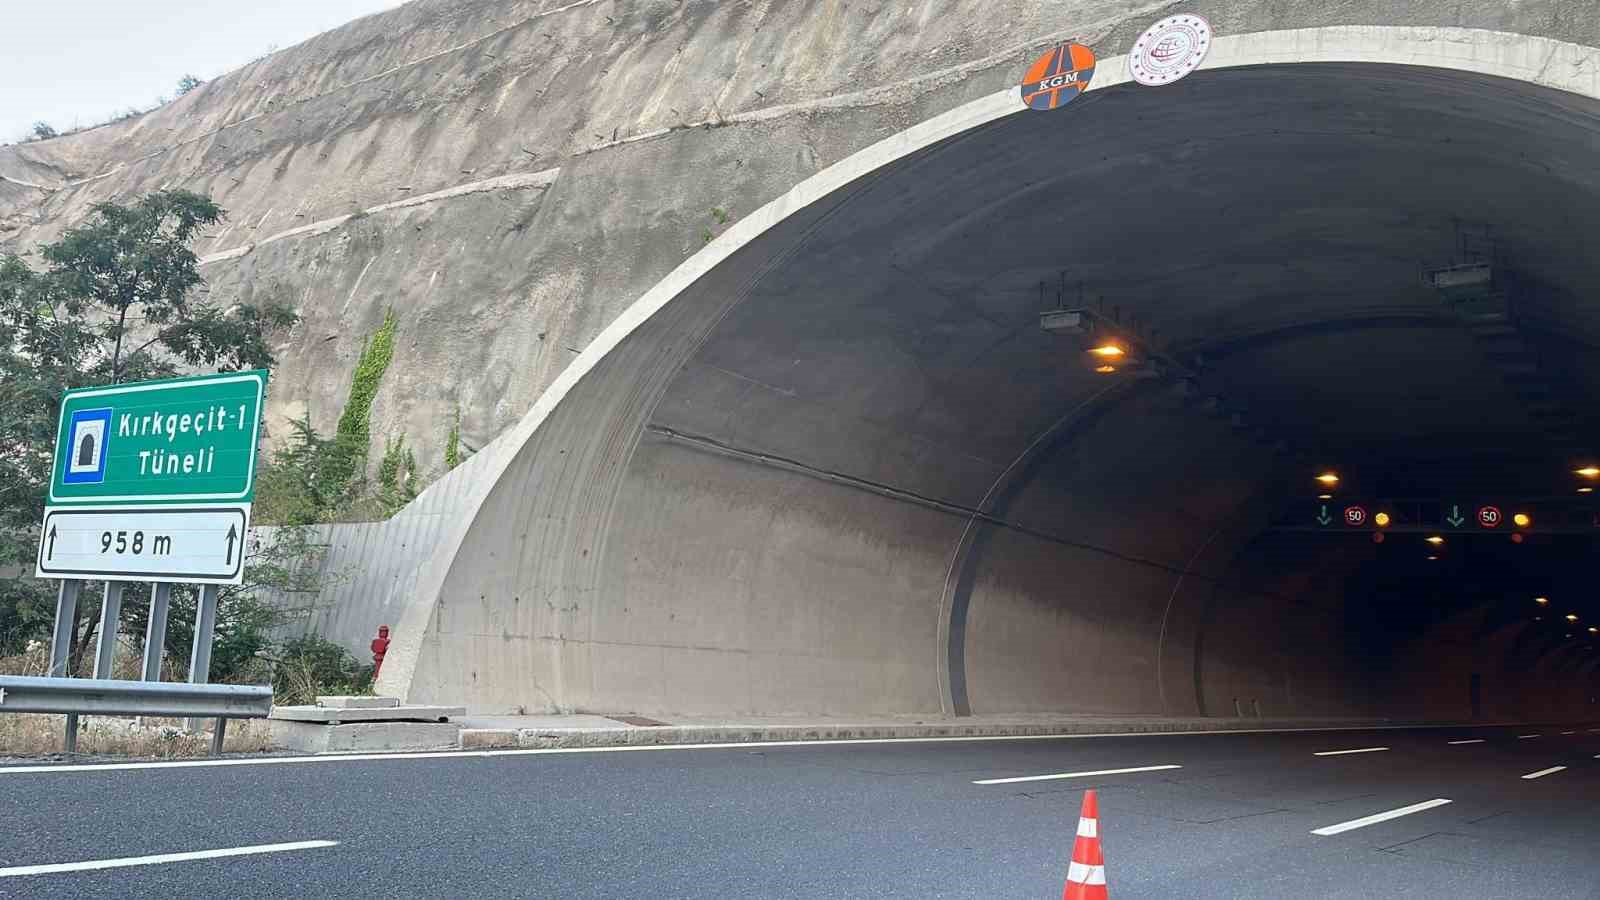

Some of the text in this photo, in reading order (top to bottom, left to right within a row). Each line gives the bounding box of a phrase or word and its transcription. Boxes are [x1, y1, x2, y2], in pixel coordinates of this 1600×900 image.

[1039, 71, 1079, 91] KGM
[118, 404, 247, 442] Kırkgeçit-1
[139, 446, 214, 475] Tüneli
[1348, 511, 1362, 522] 50
[1482, 511, 1497, 522] 50
[101, 531, 171, 555] 958 m
